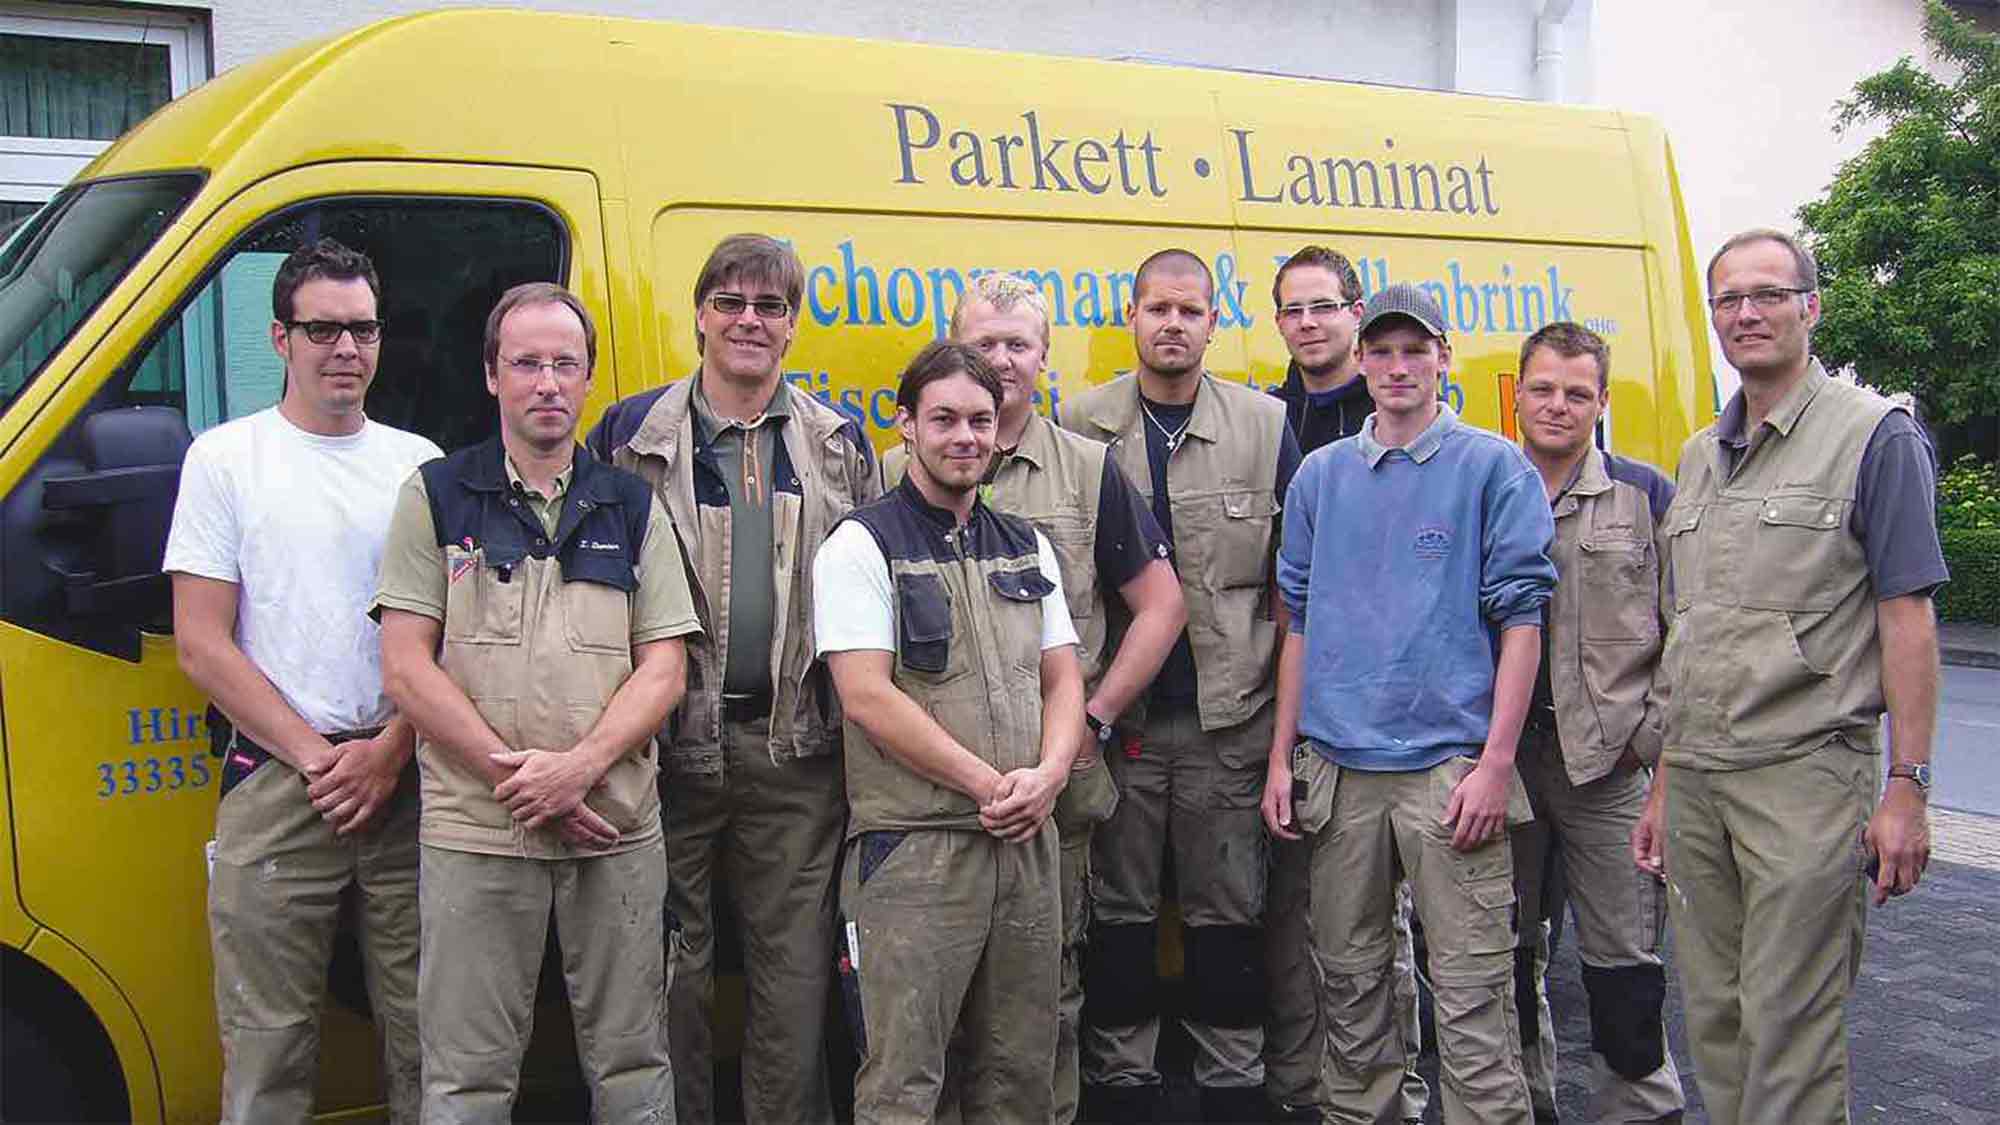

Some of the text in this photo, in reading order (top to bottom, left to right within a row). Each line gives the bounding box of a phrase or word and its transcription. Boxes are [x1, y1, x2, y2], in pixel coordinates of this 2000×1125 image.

[884, 102, 1168, 198] Parkett
[1228, 128, 1500, 216] Laminat
[1213, 253, 1254, 328] &
[96, 752, 210, 798] 33335
